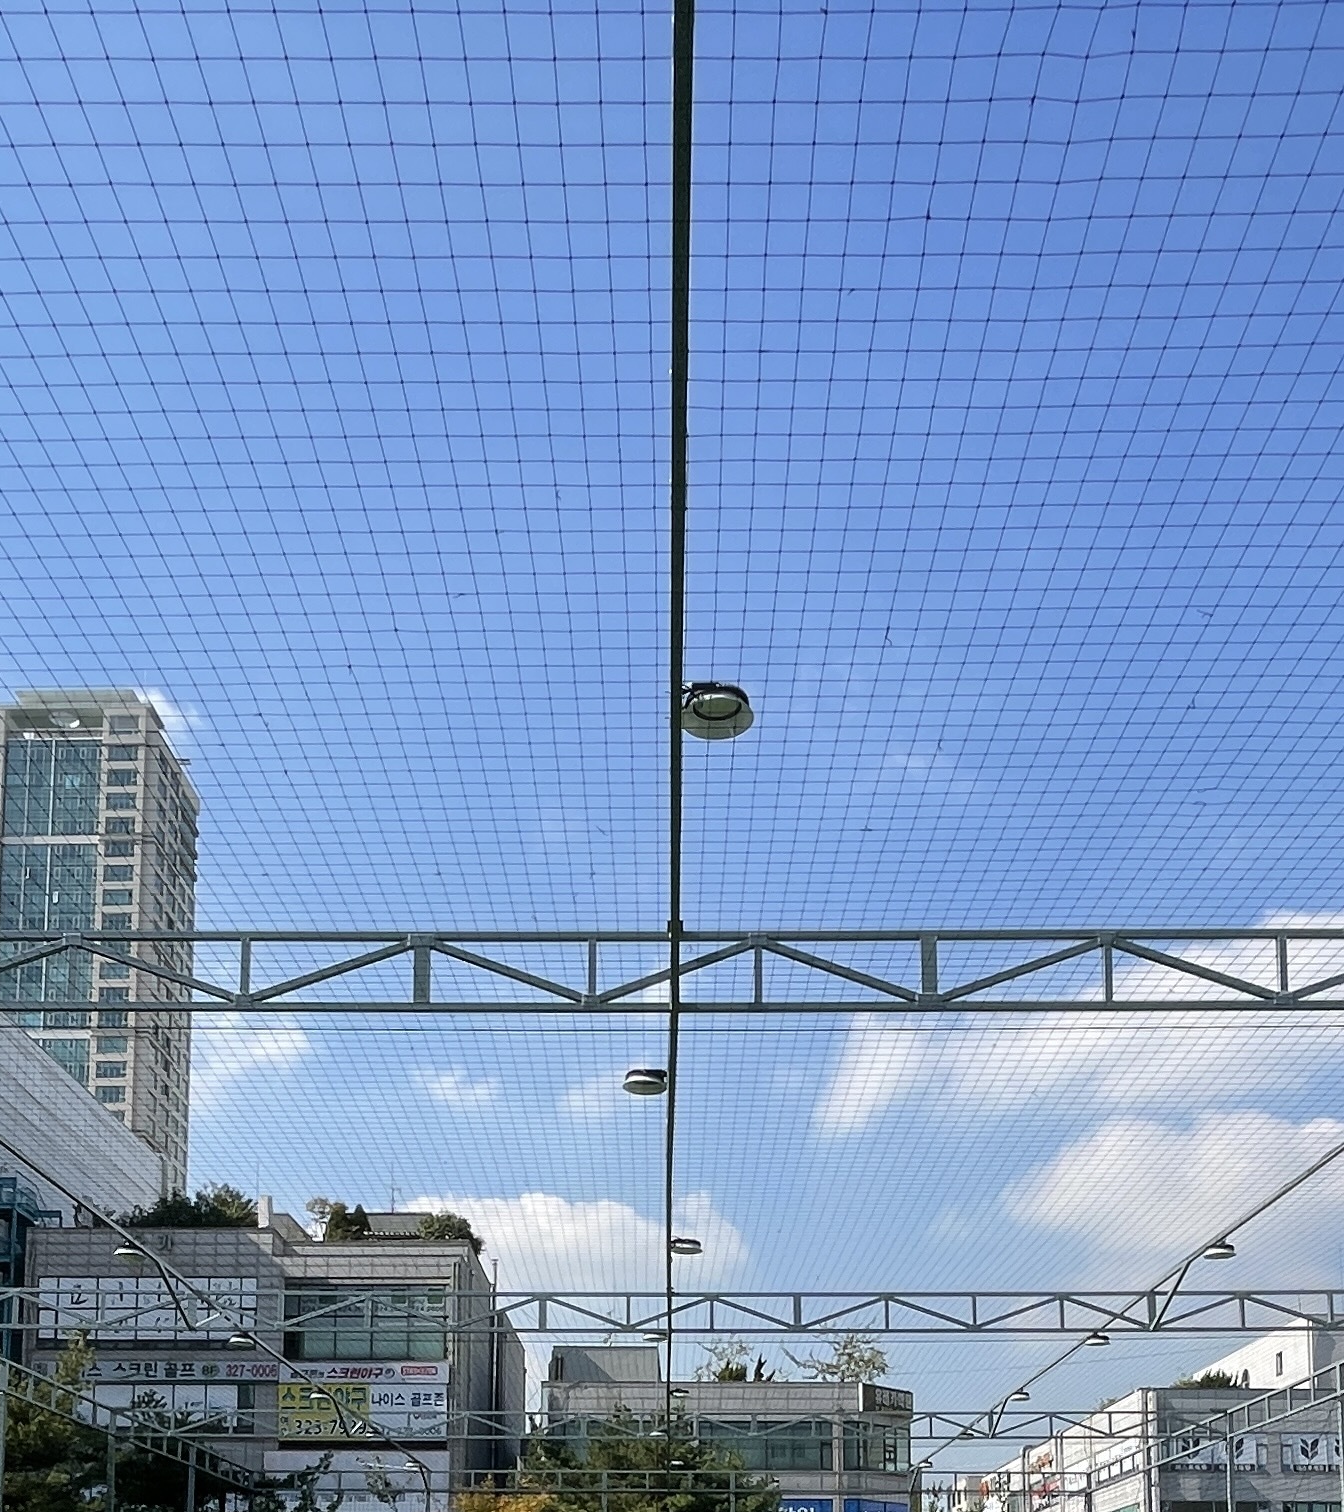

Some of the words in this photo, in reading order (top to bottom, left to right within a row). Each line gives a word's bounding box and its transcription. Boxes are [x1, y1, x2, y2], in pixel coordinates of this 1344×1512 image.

[113, 1363, 158, 1379] 스크린
[164, 1363, 195, 1378] 골프
[371, 1392, 406, 1407] 나이스
[410, 1392, 445, 1407] 골프존
